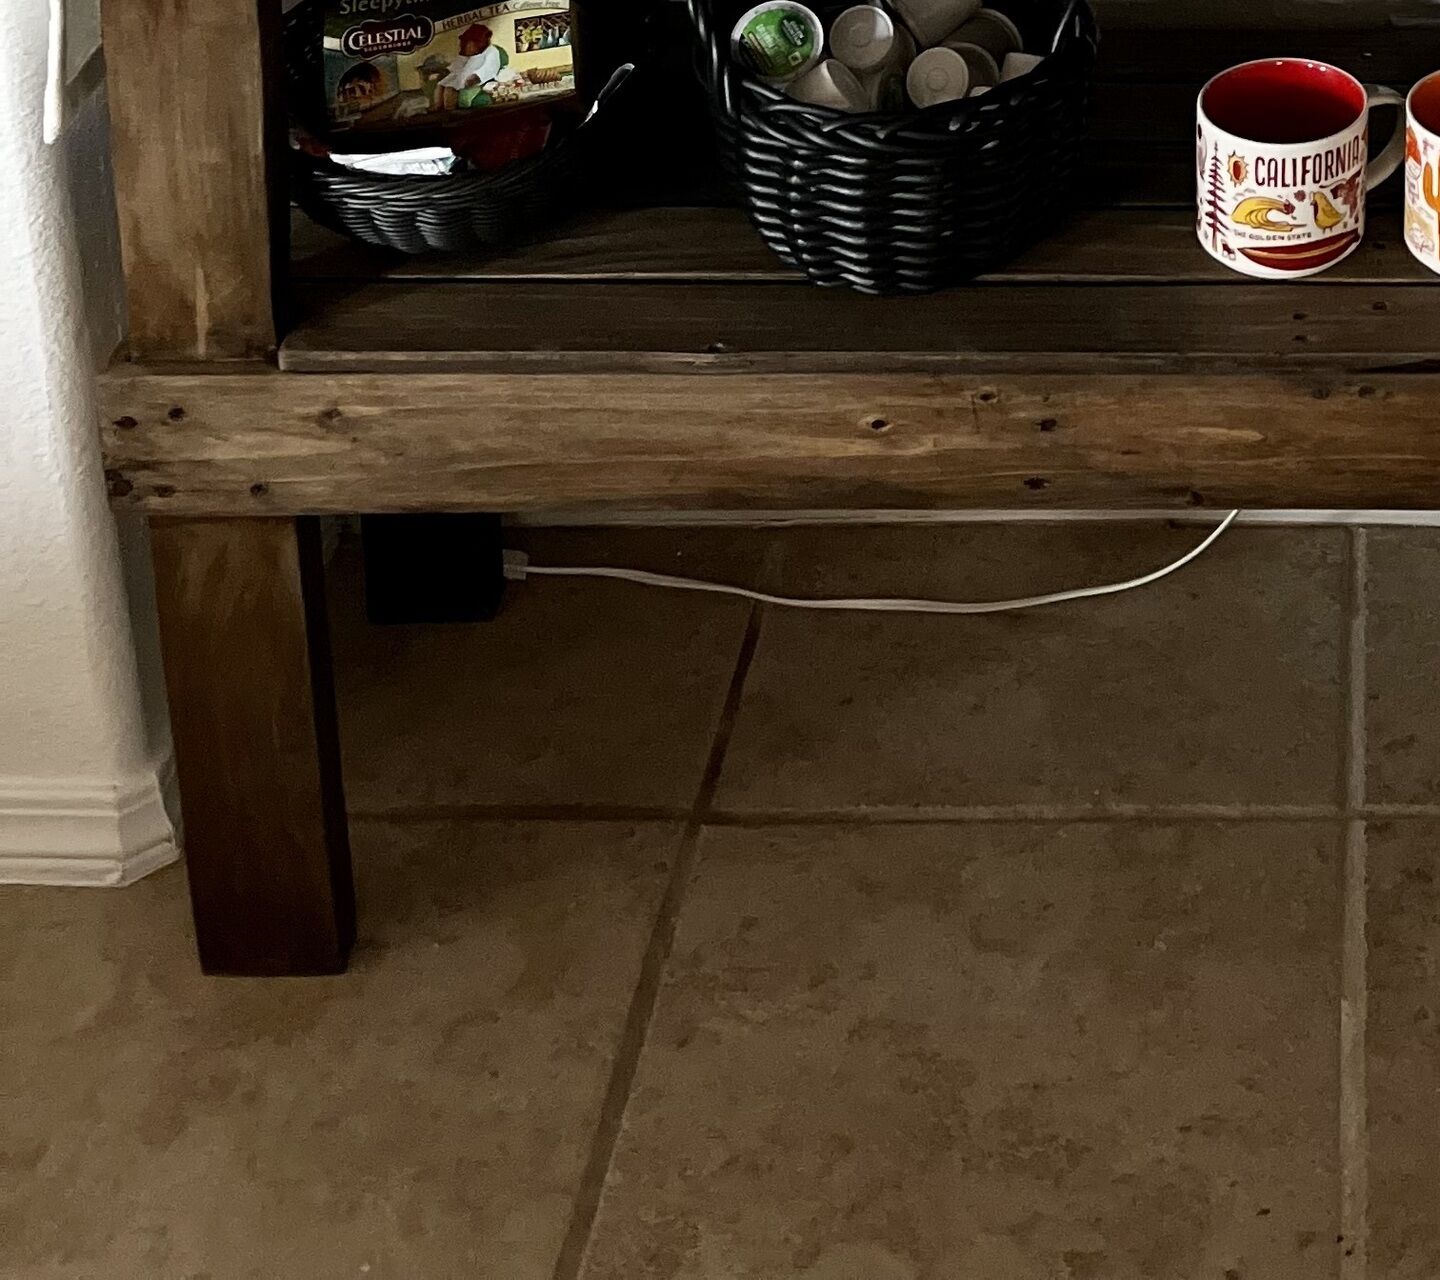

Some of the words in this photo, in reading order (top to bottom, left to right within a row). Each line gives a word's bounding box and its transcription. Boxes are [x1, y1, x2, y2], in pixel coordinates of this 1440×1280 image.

[442, 10, 486, 30] HERBAL
[489, 4, 510, 16] TEA
[348, 26, 426, 50] CELESTIAL
[1255, 135, 1360, 187] CALIFORNIA
[1248, 233, 1285, 241] GOLDEN
[1287, 231, 1312, 241] STATE
